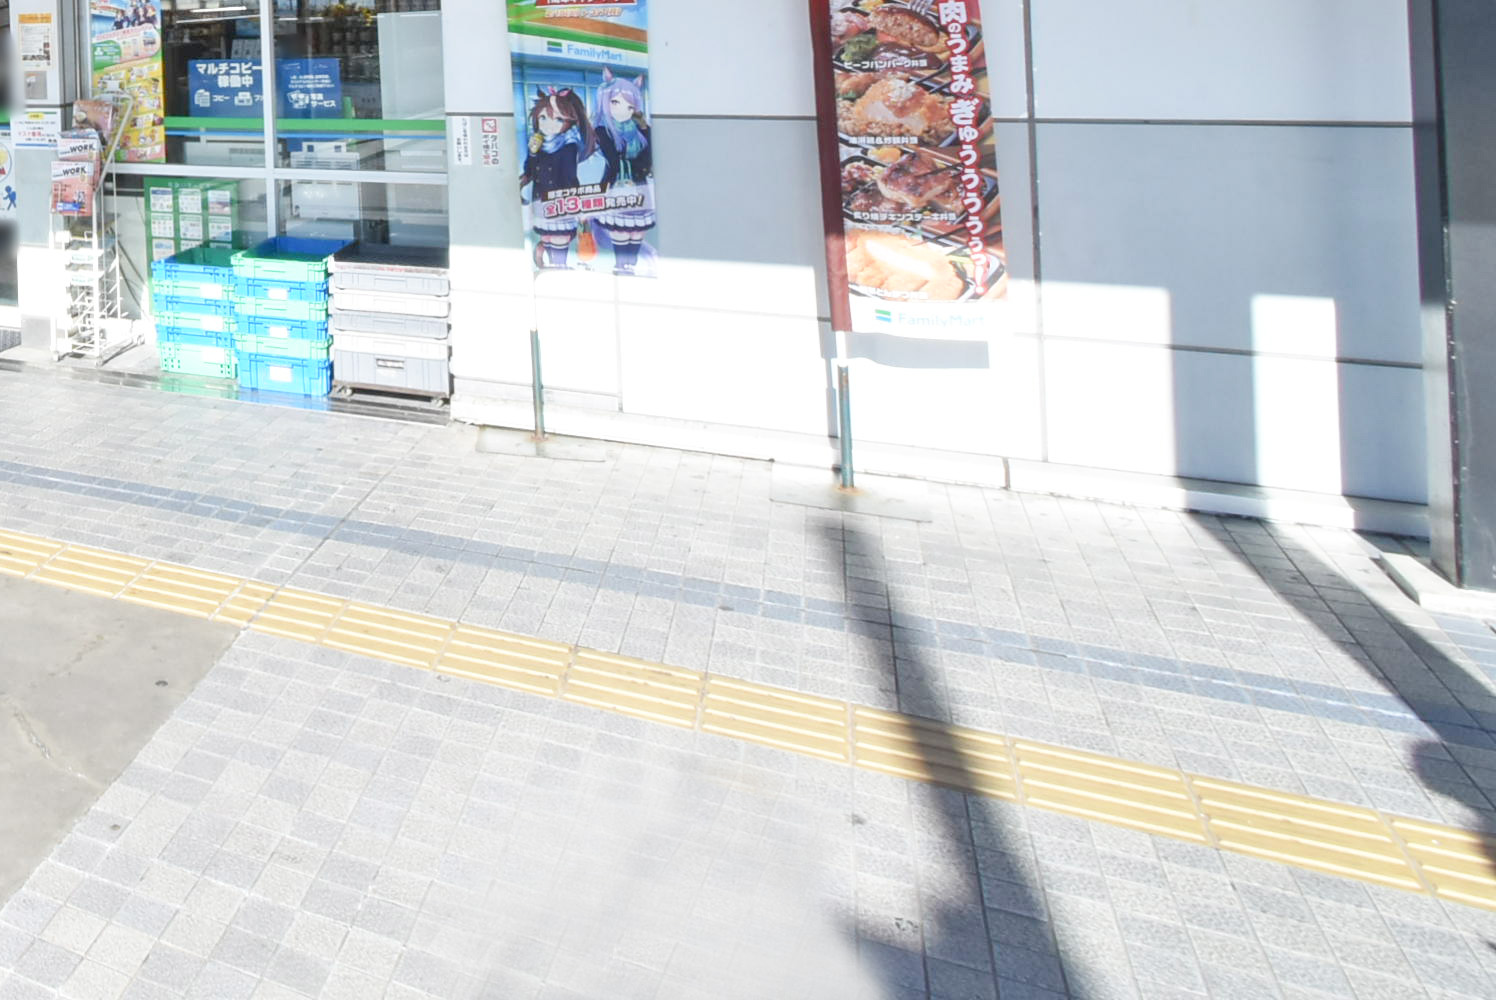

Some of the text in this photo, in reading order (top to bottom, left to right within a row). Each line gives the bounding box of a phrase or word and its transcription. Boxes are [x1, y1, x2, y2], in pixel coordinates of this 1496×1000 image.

[567, 44, 622, 60] FamilyMart
[844, 59, 928, 69] ビーフハンバーグ弁当
[898, 313, 985, 328] FamilyMart
